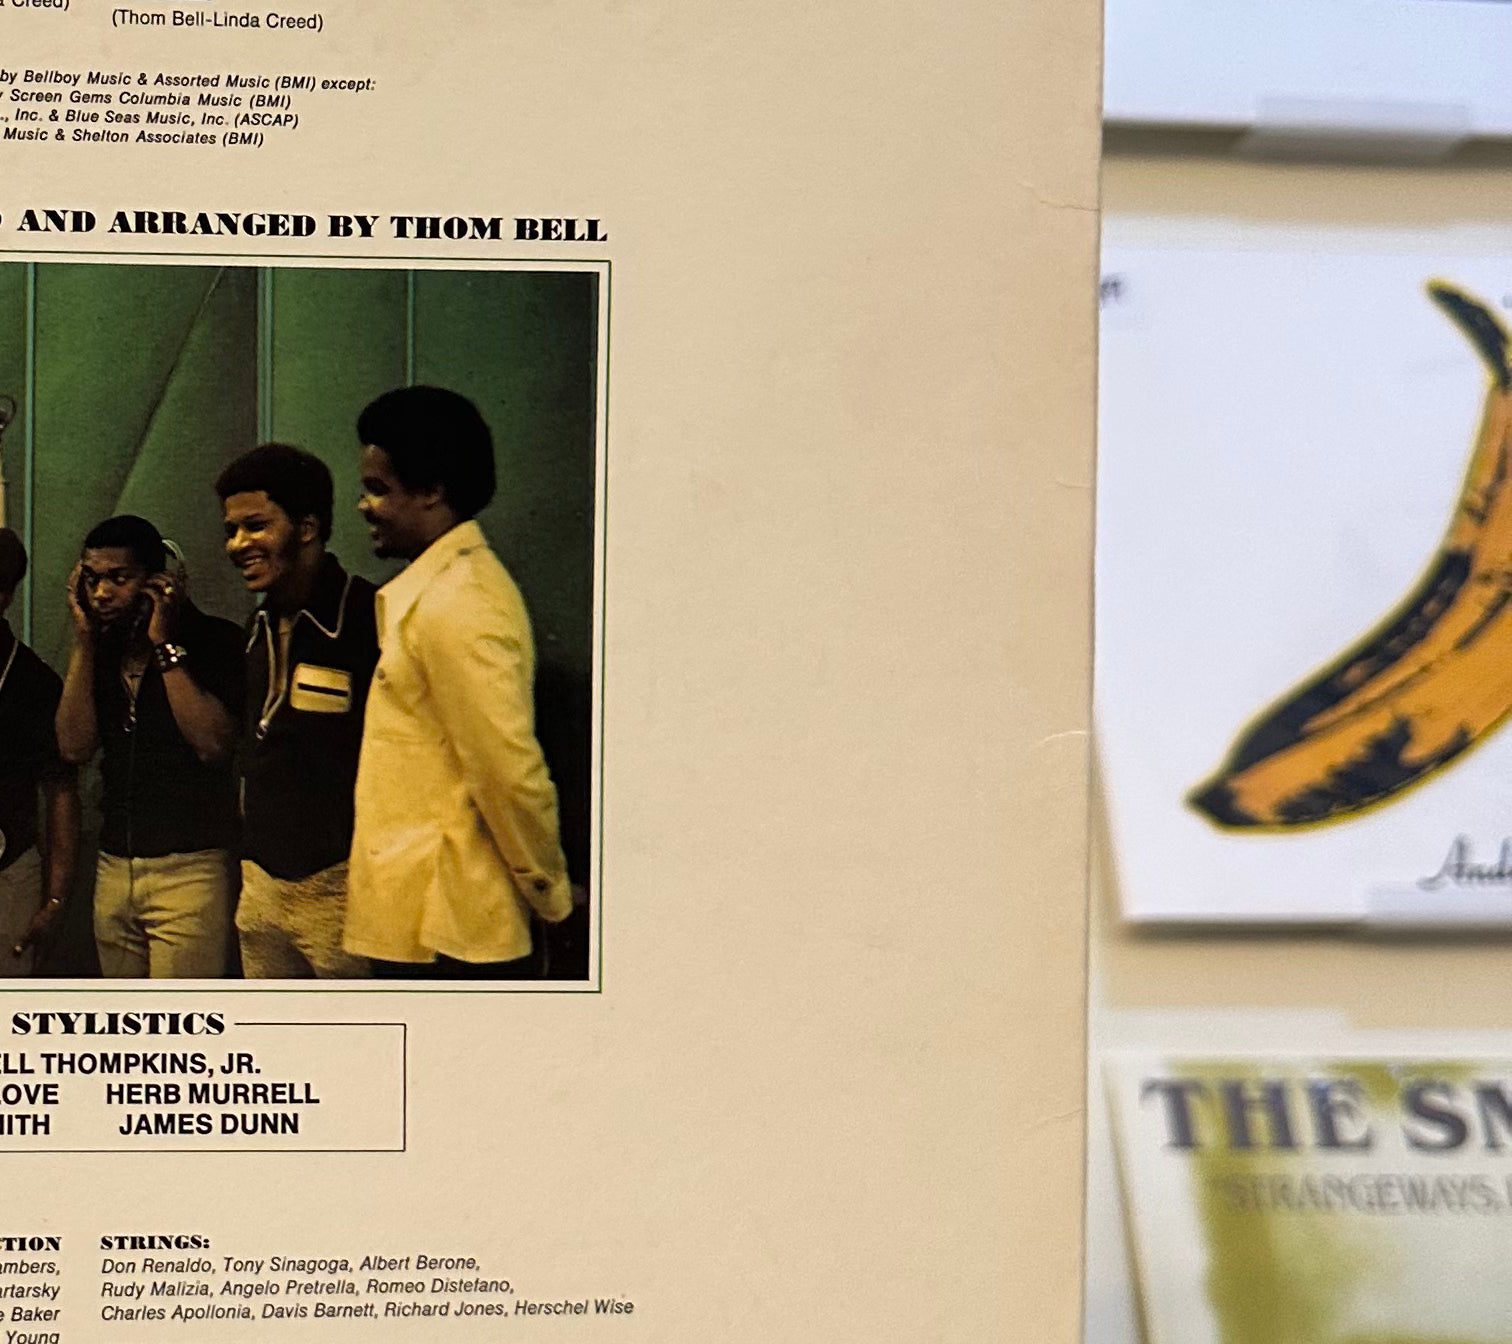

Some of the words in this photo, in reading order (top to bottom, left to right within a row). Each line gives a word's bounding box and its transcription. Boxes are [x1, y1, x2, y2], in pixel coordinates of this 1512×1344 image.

[3, 127, 48, 141] Music
[55, 128, 65, 141] &
[72, 128, 129, 142] Shelton
[136, 130, 216, 144] Associates
[223, 132, 264, 148] (BMI)
[16, 209, 96, 232] AND
[107, 211, 316, 237] ARRANGED
[327, 215, 380, 238] BY
[390, 216, 504, 240] THOM
[514, 218, 608, 242] BELL
[12, 1012, 225, 1035] STYLISTICS
[40, 1052, 214, 1078] THOMPKINS,
[220, 1053, 261, 1074] JR.
[106, 1083, 181, 1104] HERB
[188, 1083, 320, 1105] MURRELL
[119, 1113, 213, 1135] JAMES
[221, 1113, 299, 1135] DUNN
[1142, 1077, 1373, 1151] THE
[100, 1234, 210, 1250] STRINGS:
[10, 1306, 61, 1322] Baker
